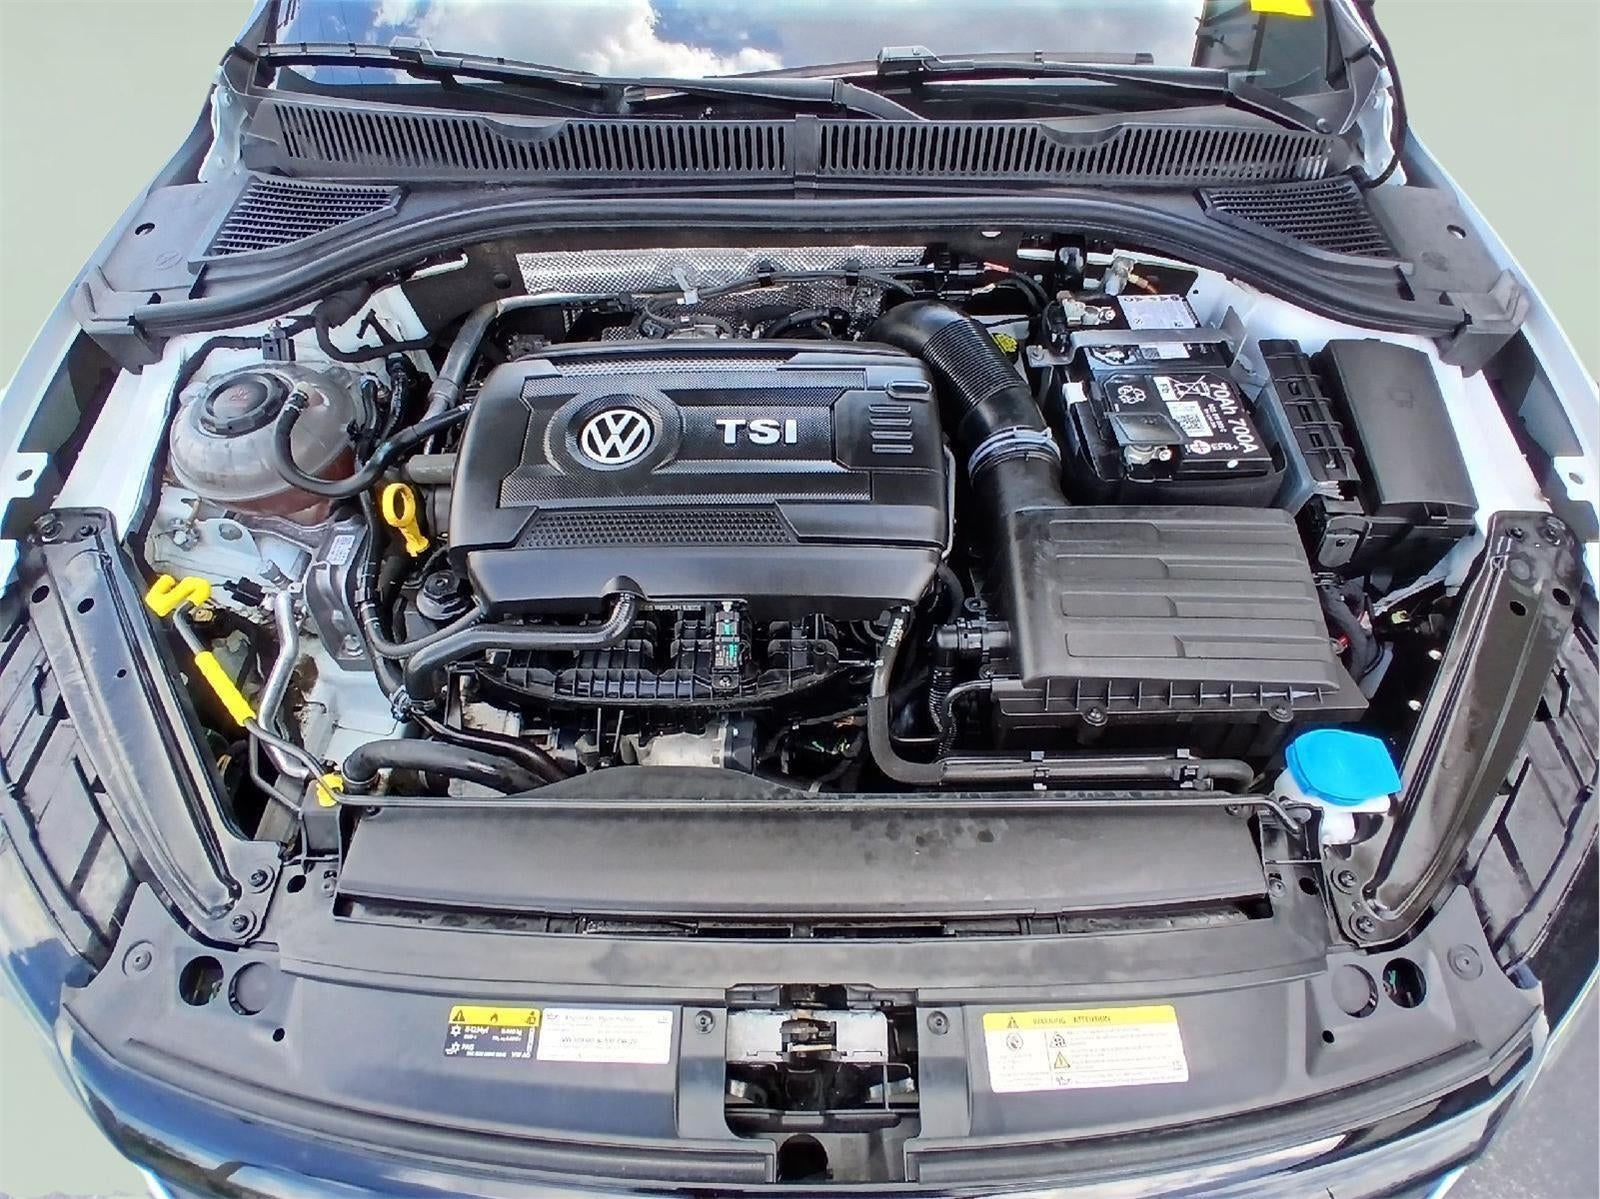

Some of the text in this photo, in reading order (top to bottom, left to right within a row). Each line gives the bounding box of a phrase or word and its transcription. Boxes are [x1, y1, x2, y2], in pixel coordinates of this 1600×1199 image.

[581, 409, 798, 464] VW TSI
[1210, 382, 1239, 415] 70Ah
[1228, 418, 1260, 453] 700A
